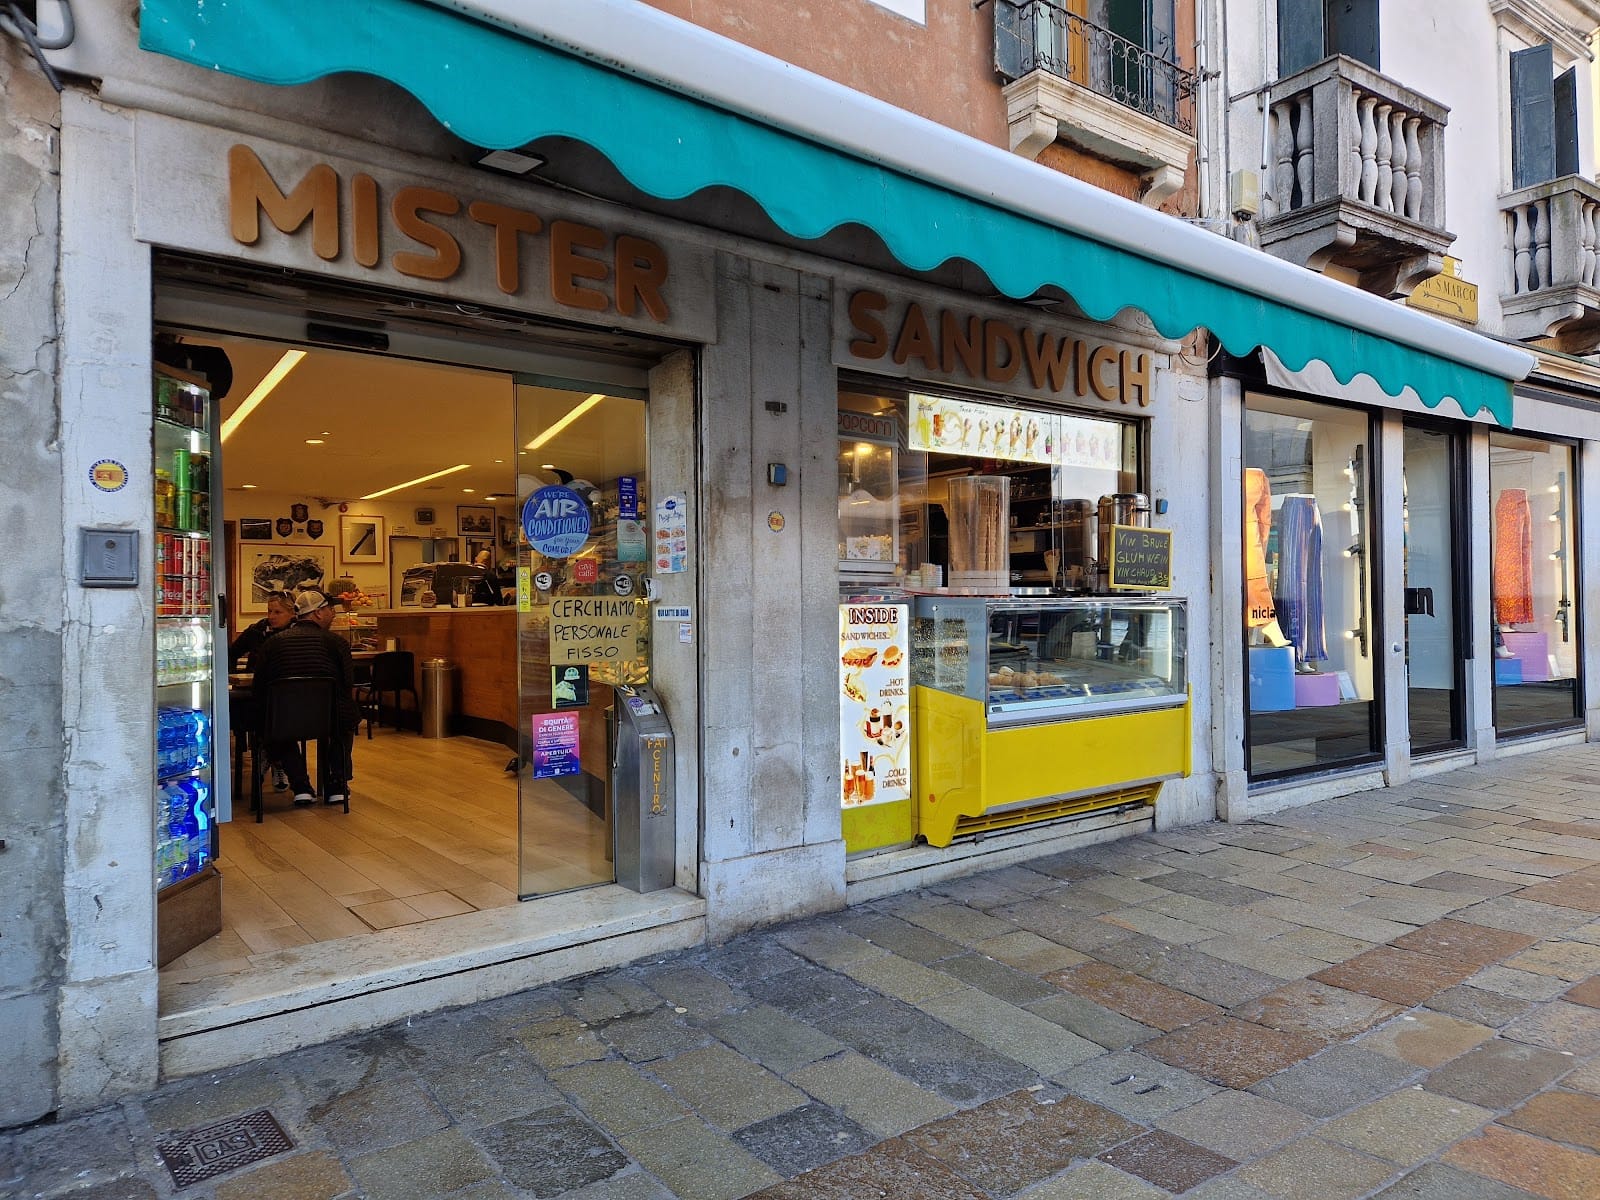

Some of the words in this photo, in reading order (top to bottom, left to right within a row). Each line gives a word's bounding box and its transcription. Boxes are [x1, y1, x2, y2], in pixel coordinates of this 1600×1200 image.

[228, 143, 669, 323] MISTER
[848, 290, 1150, 408] SANDWICH
[534, 498, 580, 518] AIR
[527, 516, 588, 537] CONDITIONED
[552, 600, 635, 618] CERCHIAMO
[848, 607, 899, 624] INSIDE
[554, 624, 631, 642] PERSONALE
[567, 646, 619, 660] FISSO
[548, 724, 574, 732] GENERE
[540, 748, 572, 756] APERTURA
[882, 777, 907, 789] DRINKS
[200, 1134, 250, 1160] GAS
